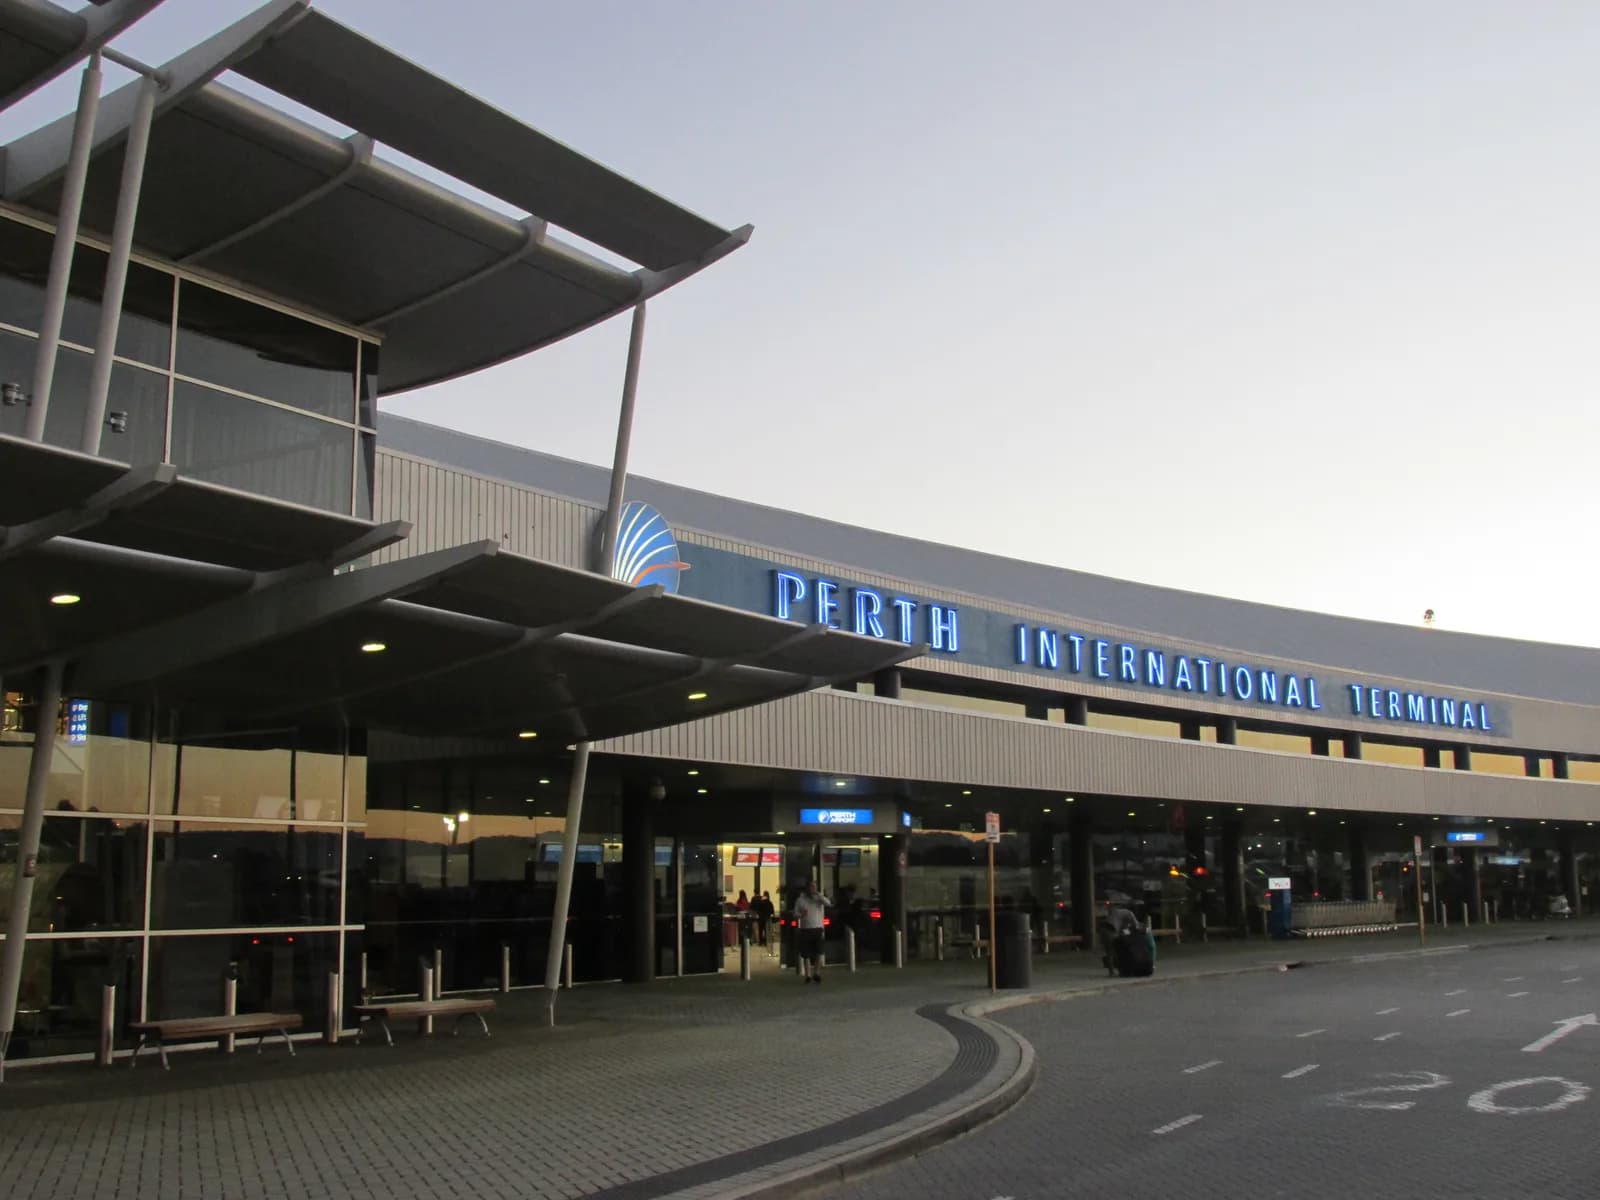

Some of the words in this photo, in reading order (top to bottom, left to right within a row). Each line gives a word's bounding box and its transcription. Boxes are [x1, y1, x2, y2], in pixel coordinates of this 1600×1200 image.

[771, 569, 959, 652] PERTH
[1014, 623, 1321, 710] INTERNATIONAL
[1351, 684, 1492, 731] TERMINAL
